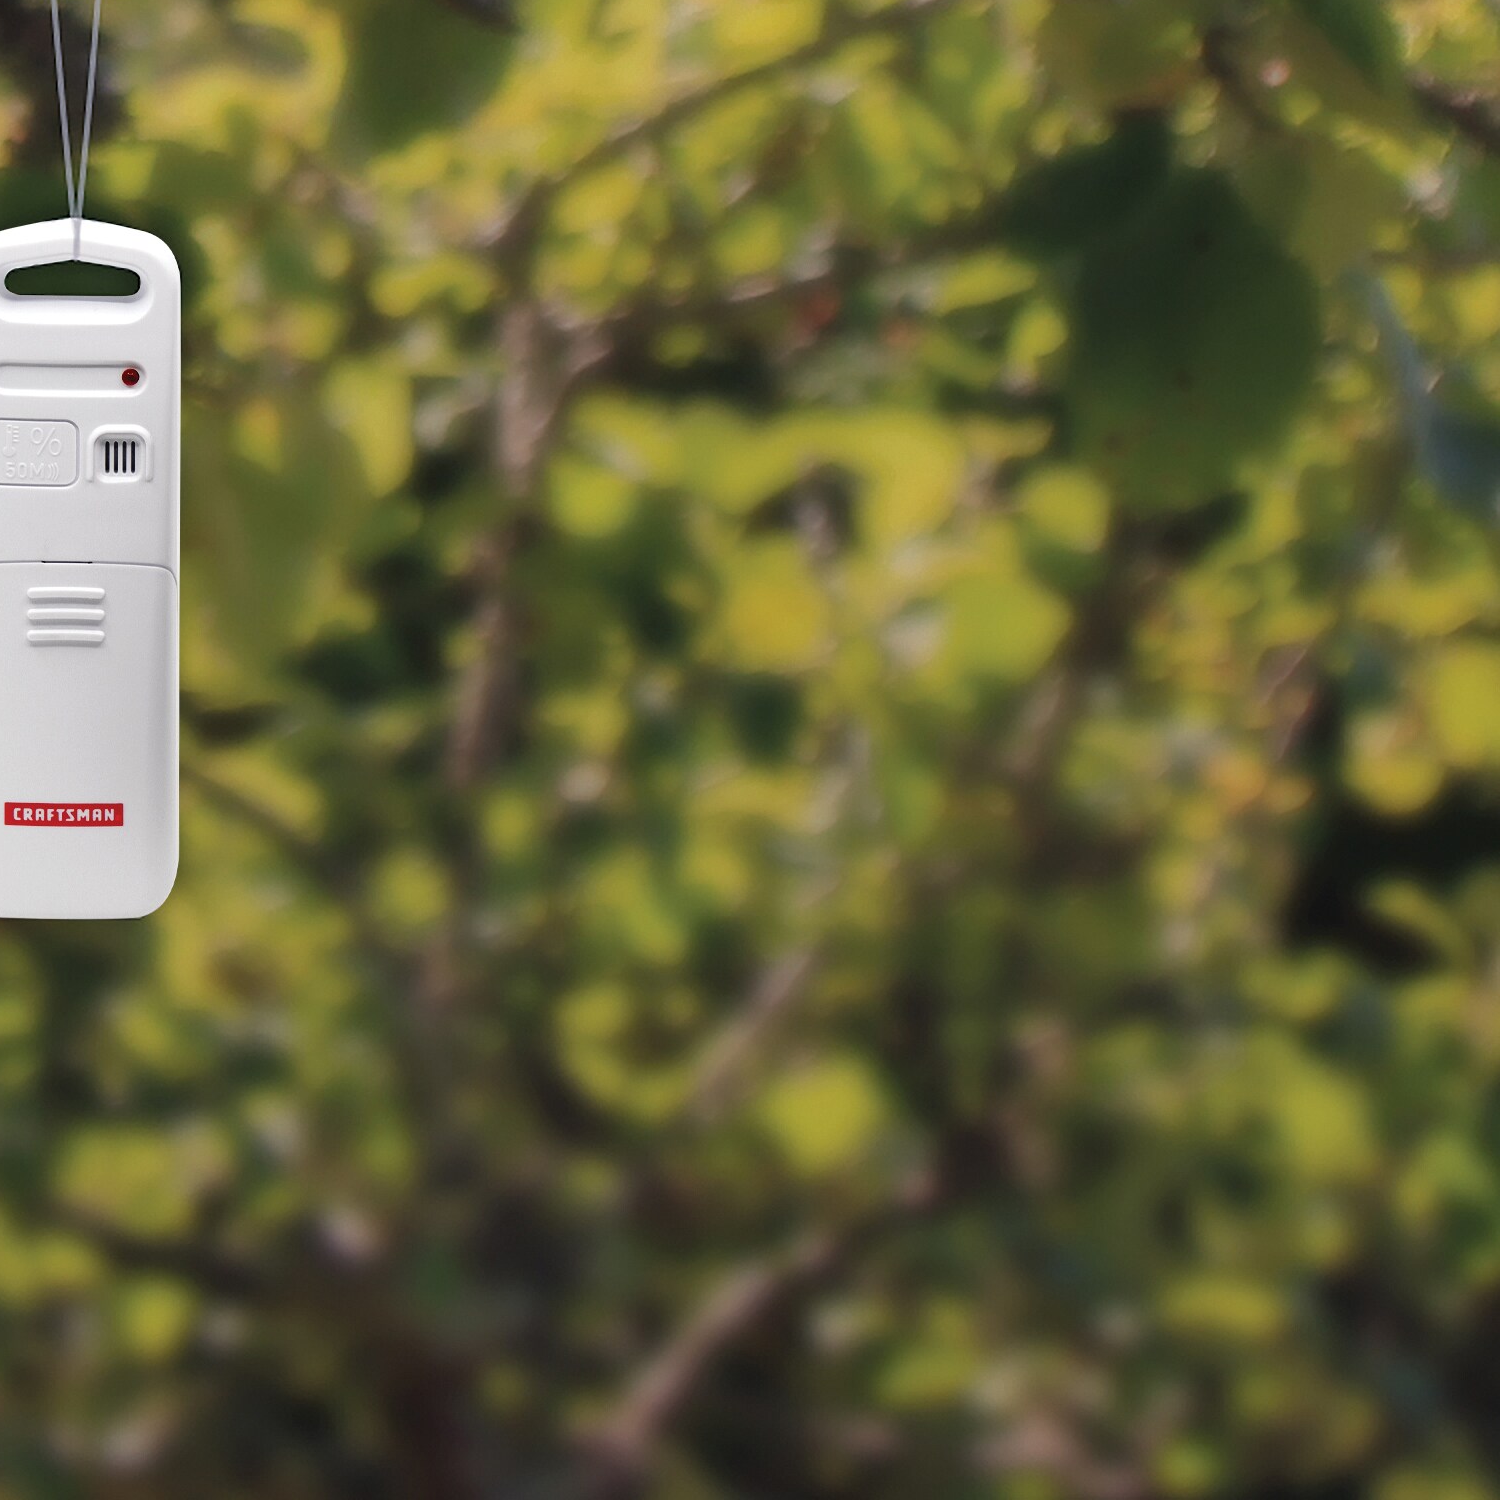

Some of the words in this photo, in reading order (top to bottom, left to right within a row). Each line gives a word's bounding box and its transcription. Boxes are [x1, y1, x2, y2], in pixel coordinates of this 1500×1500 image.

[31, 427, 62, 456] %
[5, 461, 45, 479] 50M
[13, 807, 115, 822] CRAFTSMAN
